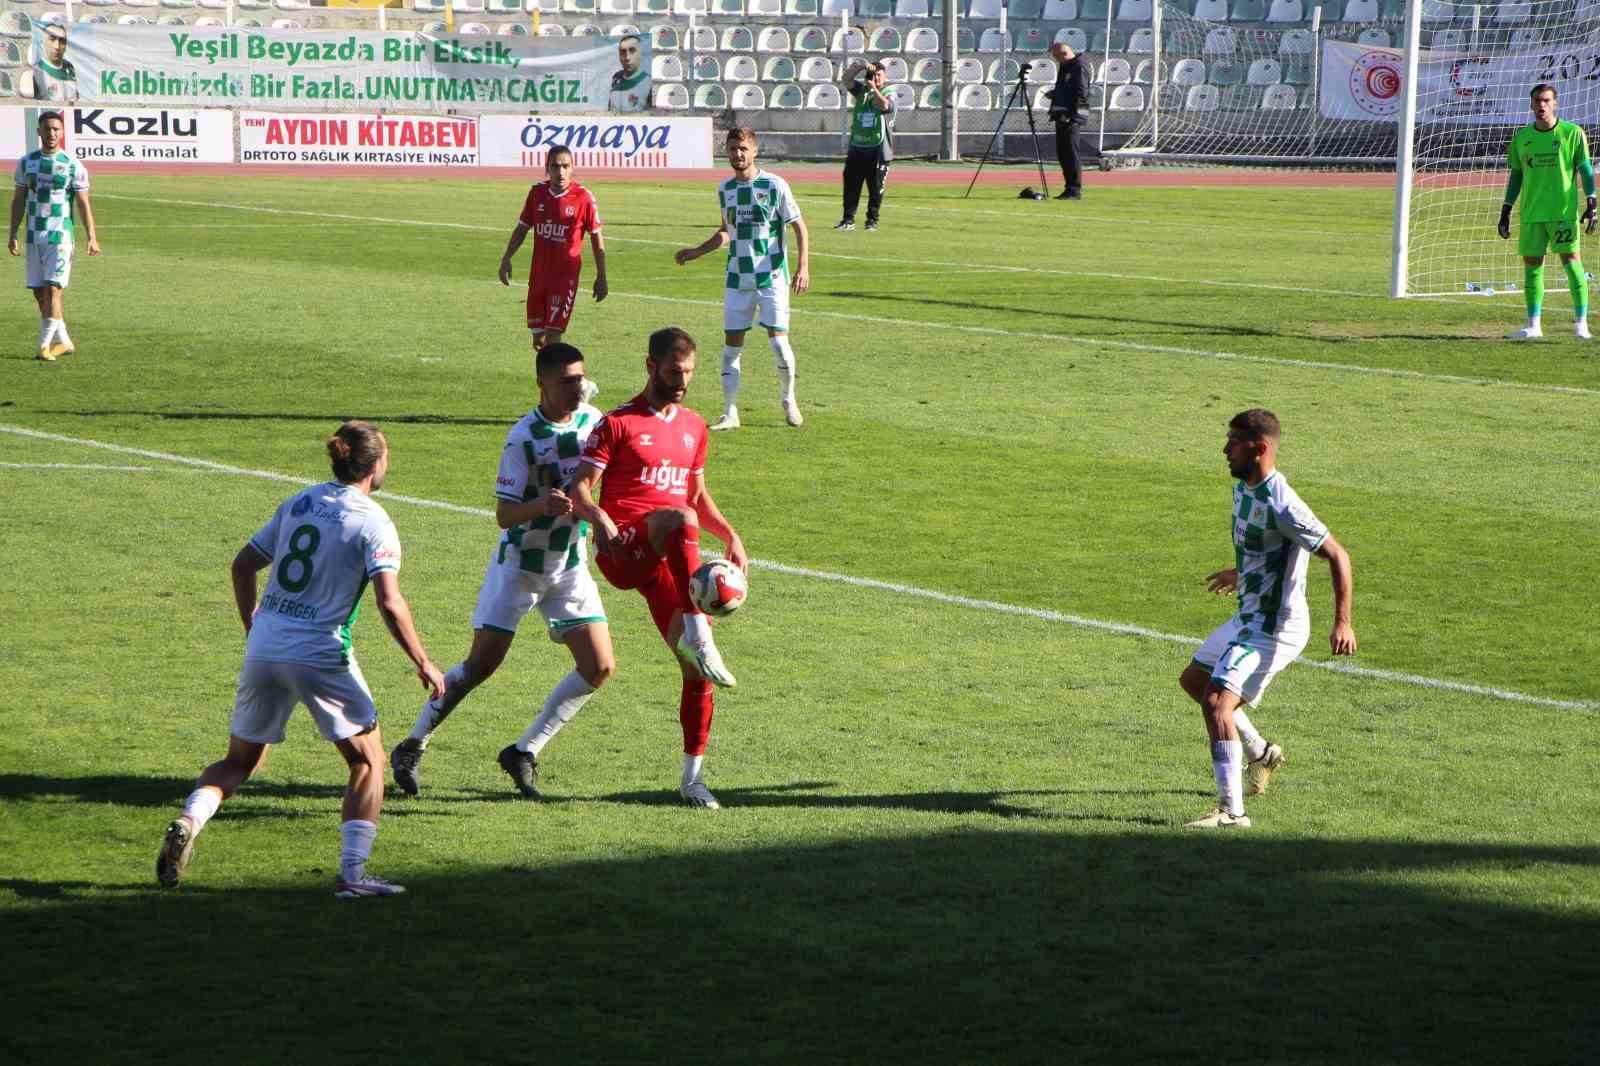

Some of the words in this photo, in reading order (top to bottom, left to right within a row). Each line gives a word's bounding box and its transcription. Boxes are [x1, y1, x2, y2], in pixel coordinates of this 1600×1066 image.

[170, 33, 238, 64] Yeşil
[248, 34, 375, 65] Beyazda
[384, 38, 426, 62] Bir
[434, 40, 522, 68] Eksik,
[101, 70, 244, 97] Kalbimizde
[251, 75, 287, 98] Bir
[74, 109, 198, 137] Kozlu
[245, 118, 266, 127] YENİ
[265, 120, 348, 146] AYDIN
[358, 114, 476, 148] KİTABEVİ
[520, 118, 671, 157] özmaya
[75, 145, 116, 160] gıda
[122, 145, 136, 158] &
[142, 145, 198, 159] imalat
[244, 151, 295, 162] DRTOTO
[301, 149, 350, 162] SAĞLIK
[355, 150, 424, 163] KIRTASİYE
[429, 151, 476, 164] İNŞAAT
[536, 219, 569, 238] uğur
[1554, 229, 1573, 243] 22
[55, 258, 65, 273] 2
[550, 306, 559, 322] 7
[640, 459, 690, 490] uğur
[277, 524, 320, 593] 8
